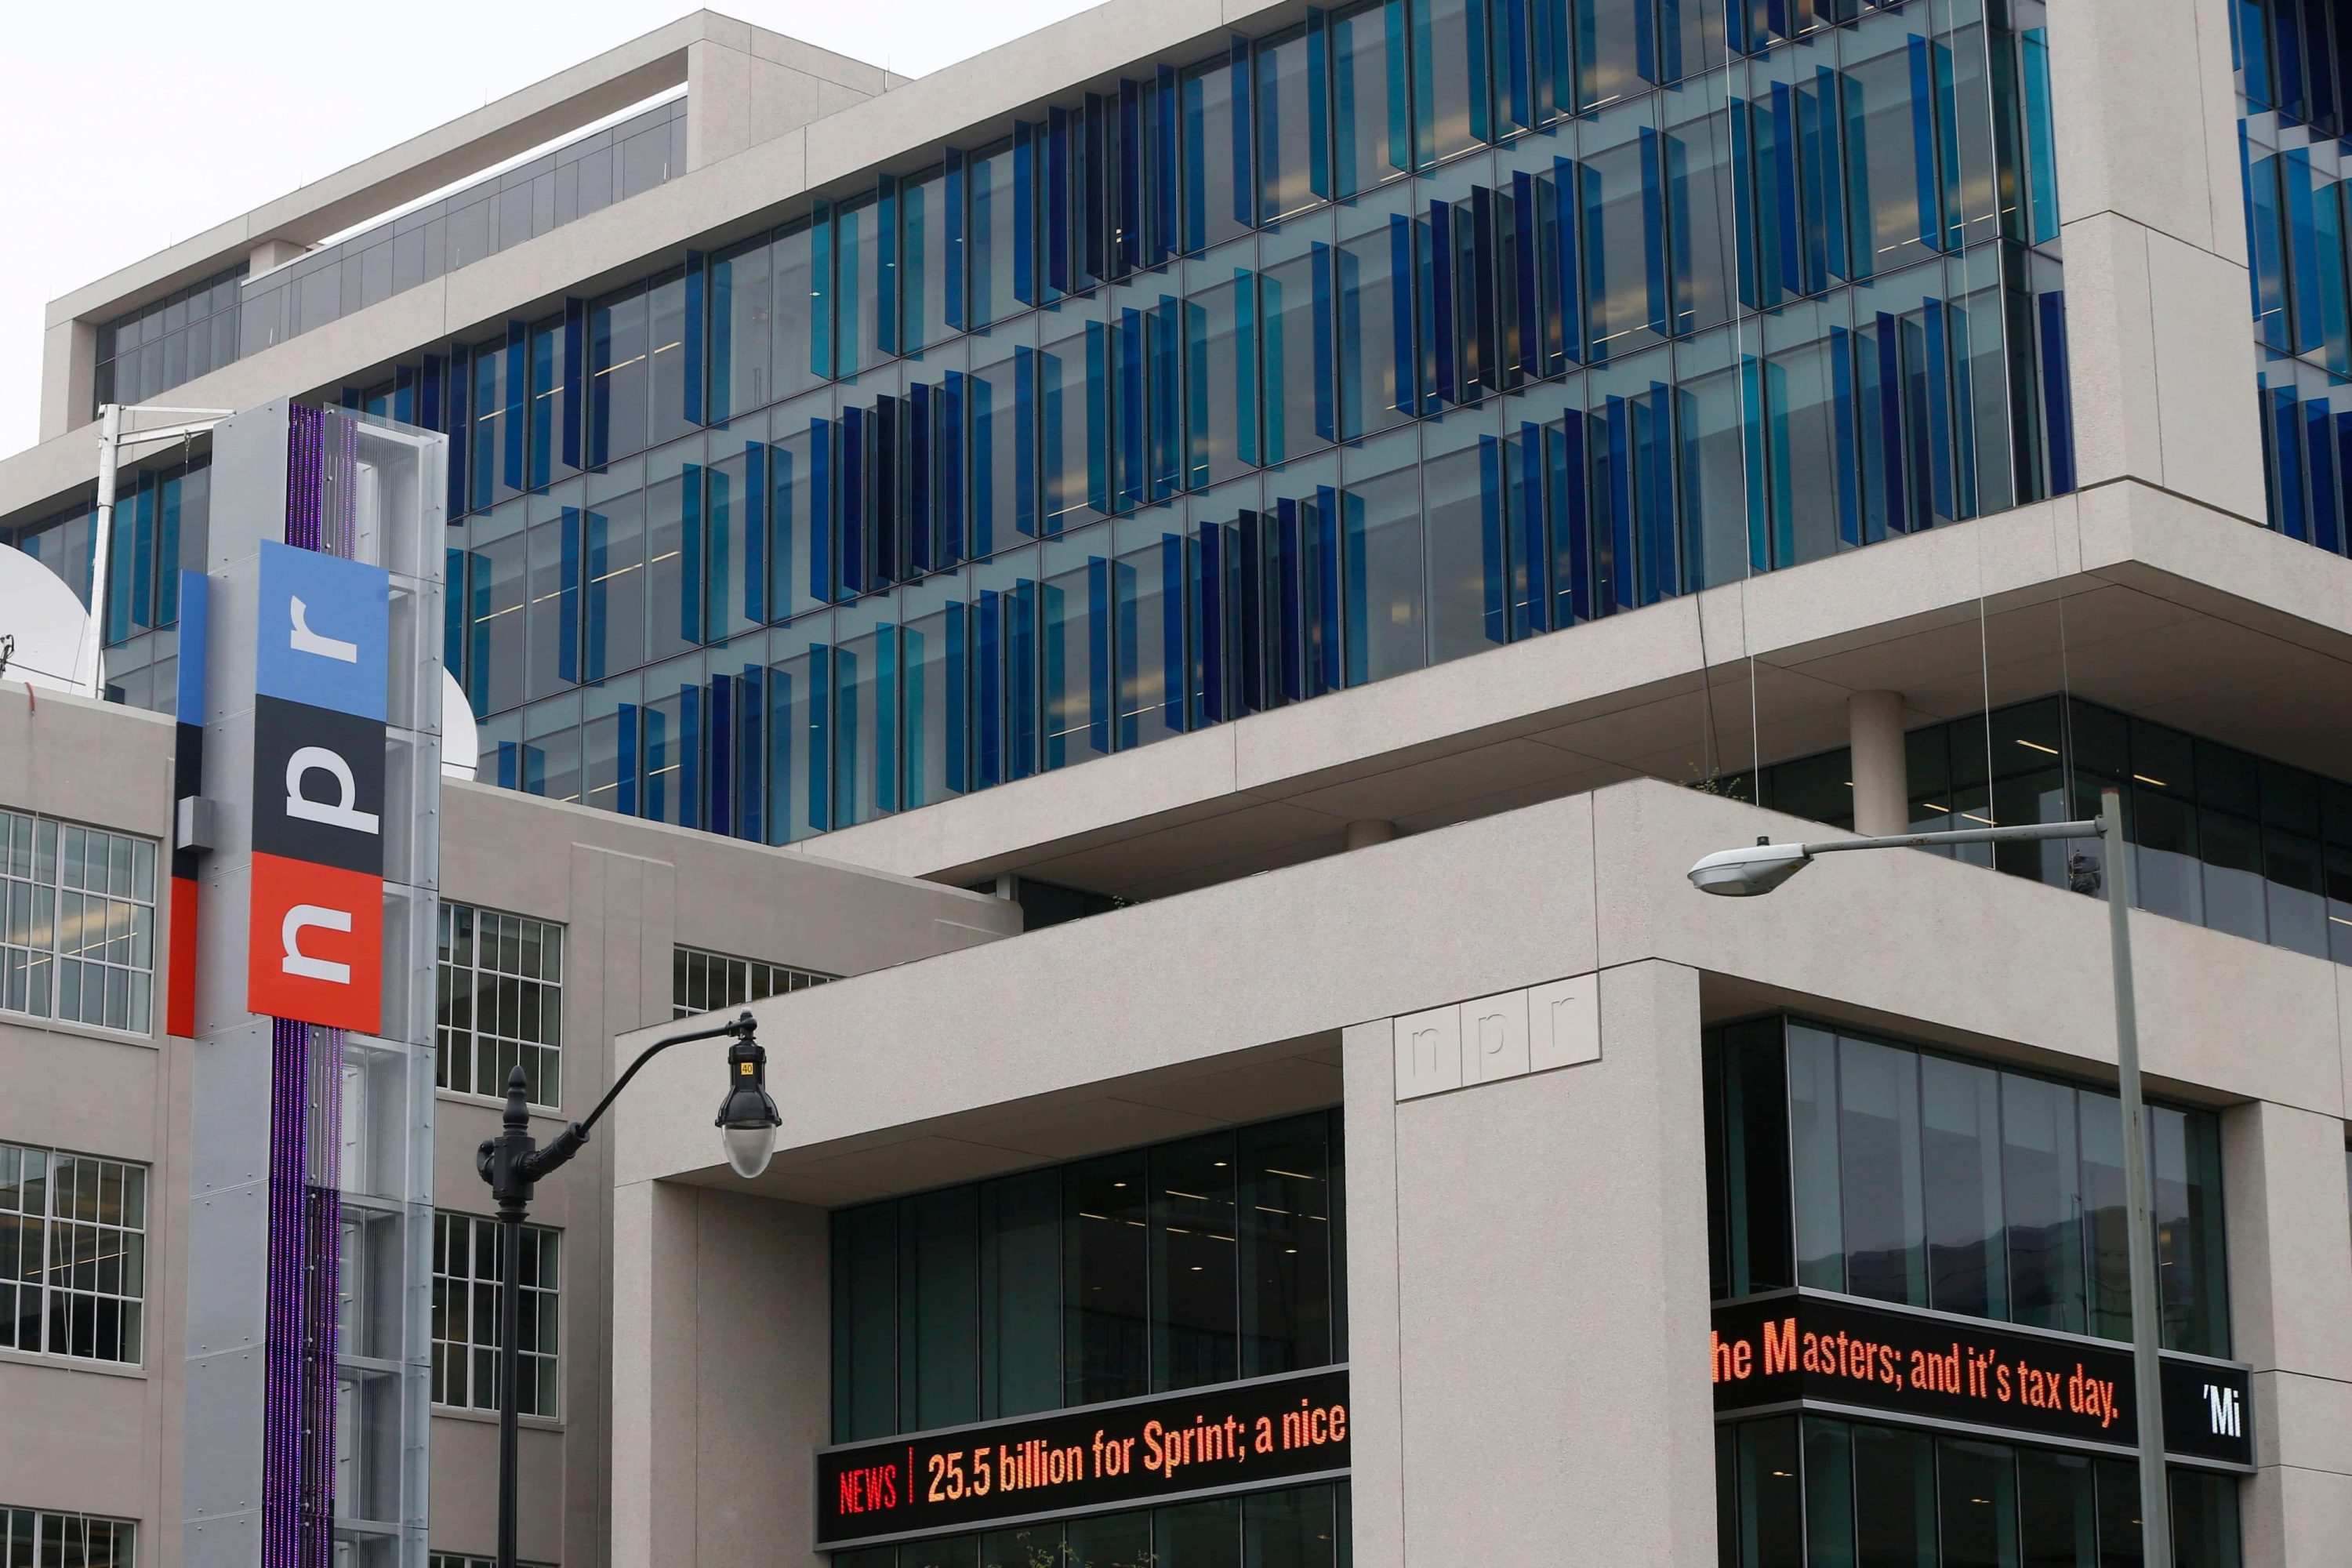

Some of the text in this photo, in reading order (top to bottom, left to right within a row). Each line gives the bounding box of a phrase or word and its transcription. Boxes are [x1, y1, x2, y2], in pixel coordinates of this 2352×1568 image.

[283, 596, 379, 983] npr
[742, 1064, 753, 1073] 40
[1412, 996, 1576, 1080] npr
[1764, 1318, 1902, 1390] Masters;
[1911, 1343, 1961, 1395] and
[1968, 1347, 2011, 1402] it's
[2017, 1361, 2062, 1410] tax
[2069, 1363, 2118, 1428] day.
[840, 1399, 1346, 1515] NEWS 25.5 billion for Sprint; a nice
